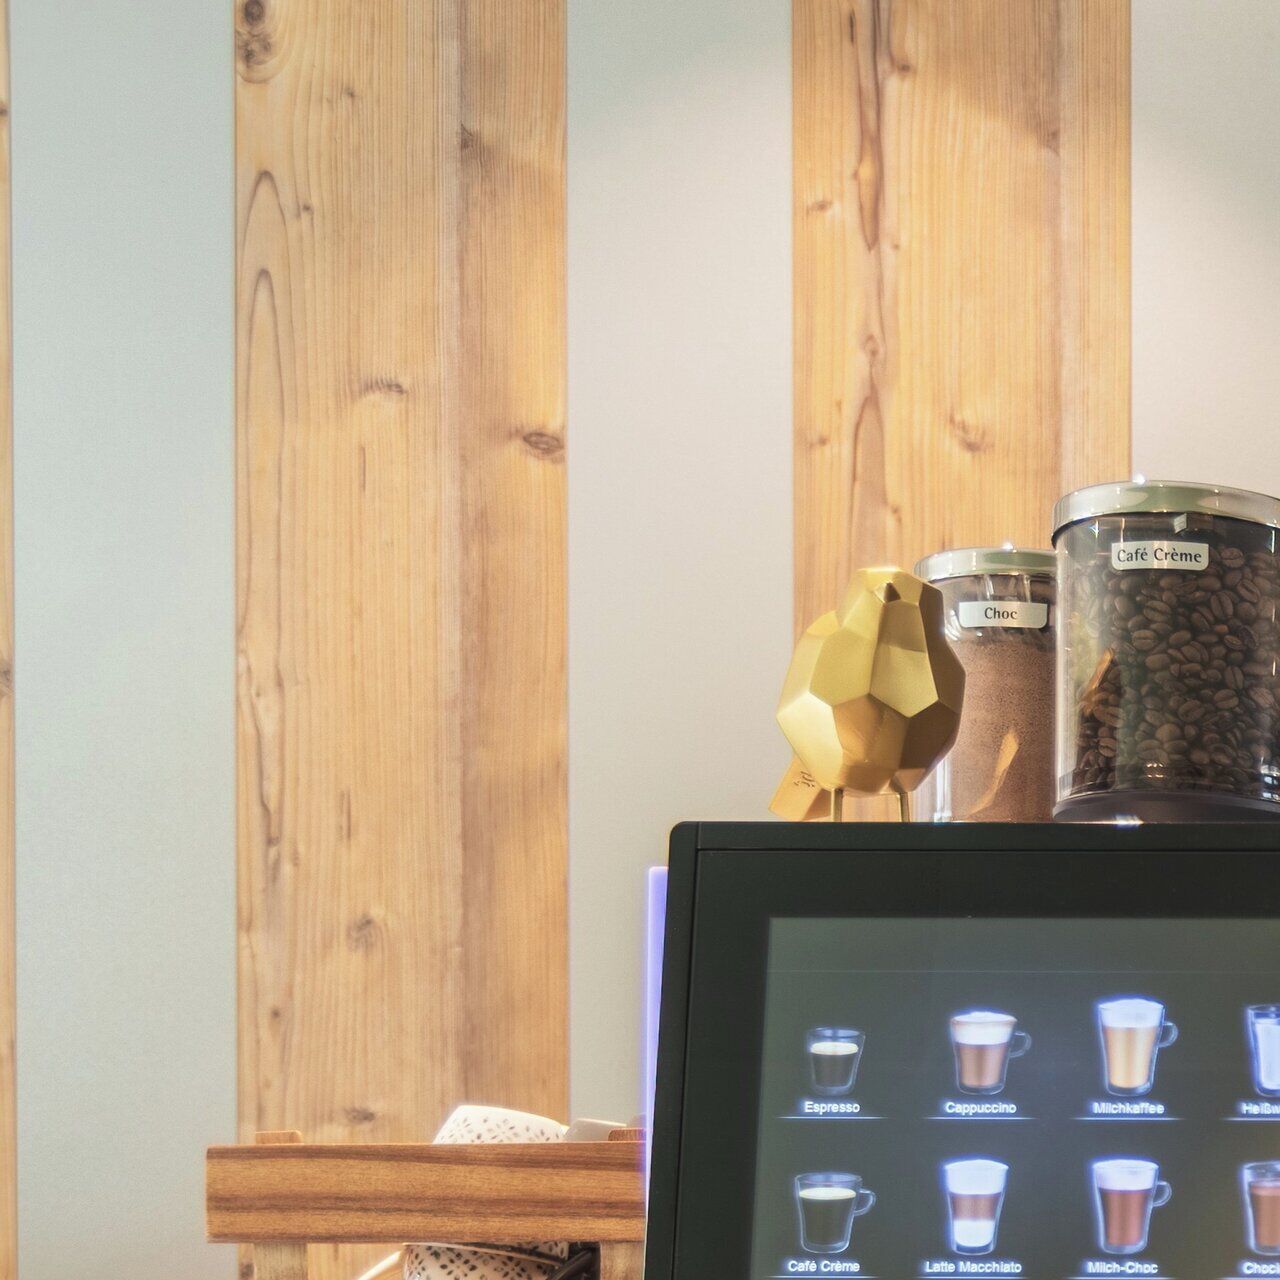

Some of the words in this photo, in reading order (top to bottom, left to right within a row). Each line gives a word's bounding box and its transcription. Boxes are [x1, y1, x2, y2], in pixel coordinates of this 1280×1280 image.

[1117, 547, 1149, 562] Café
[1153, 547, 1202, 563] Crème
[984, 607, 1018, 620] Choc
[804, 1102, 861, 1115] Espresso
[945, 1101, 1017, 1116] Cappuccino
[1093, 1102, 1165, 1115] Milchkaffee
[788, 1259, 817, 1273] Café
[820, 1259, 861, 1273] Crème
[925, 1261, 956, 1274] Latte
[958, 1261, 1022, 1274] Macchiato
[1087, 1262, 1159, 1275] Milch-Choc
